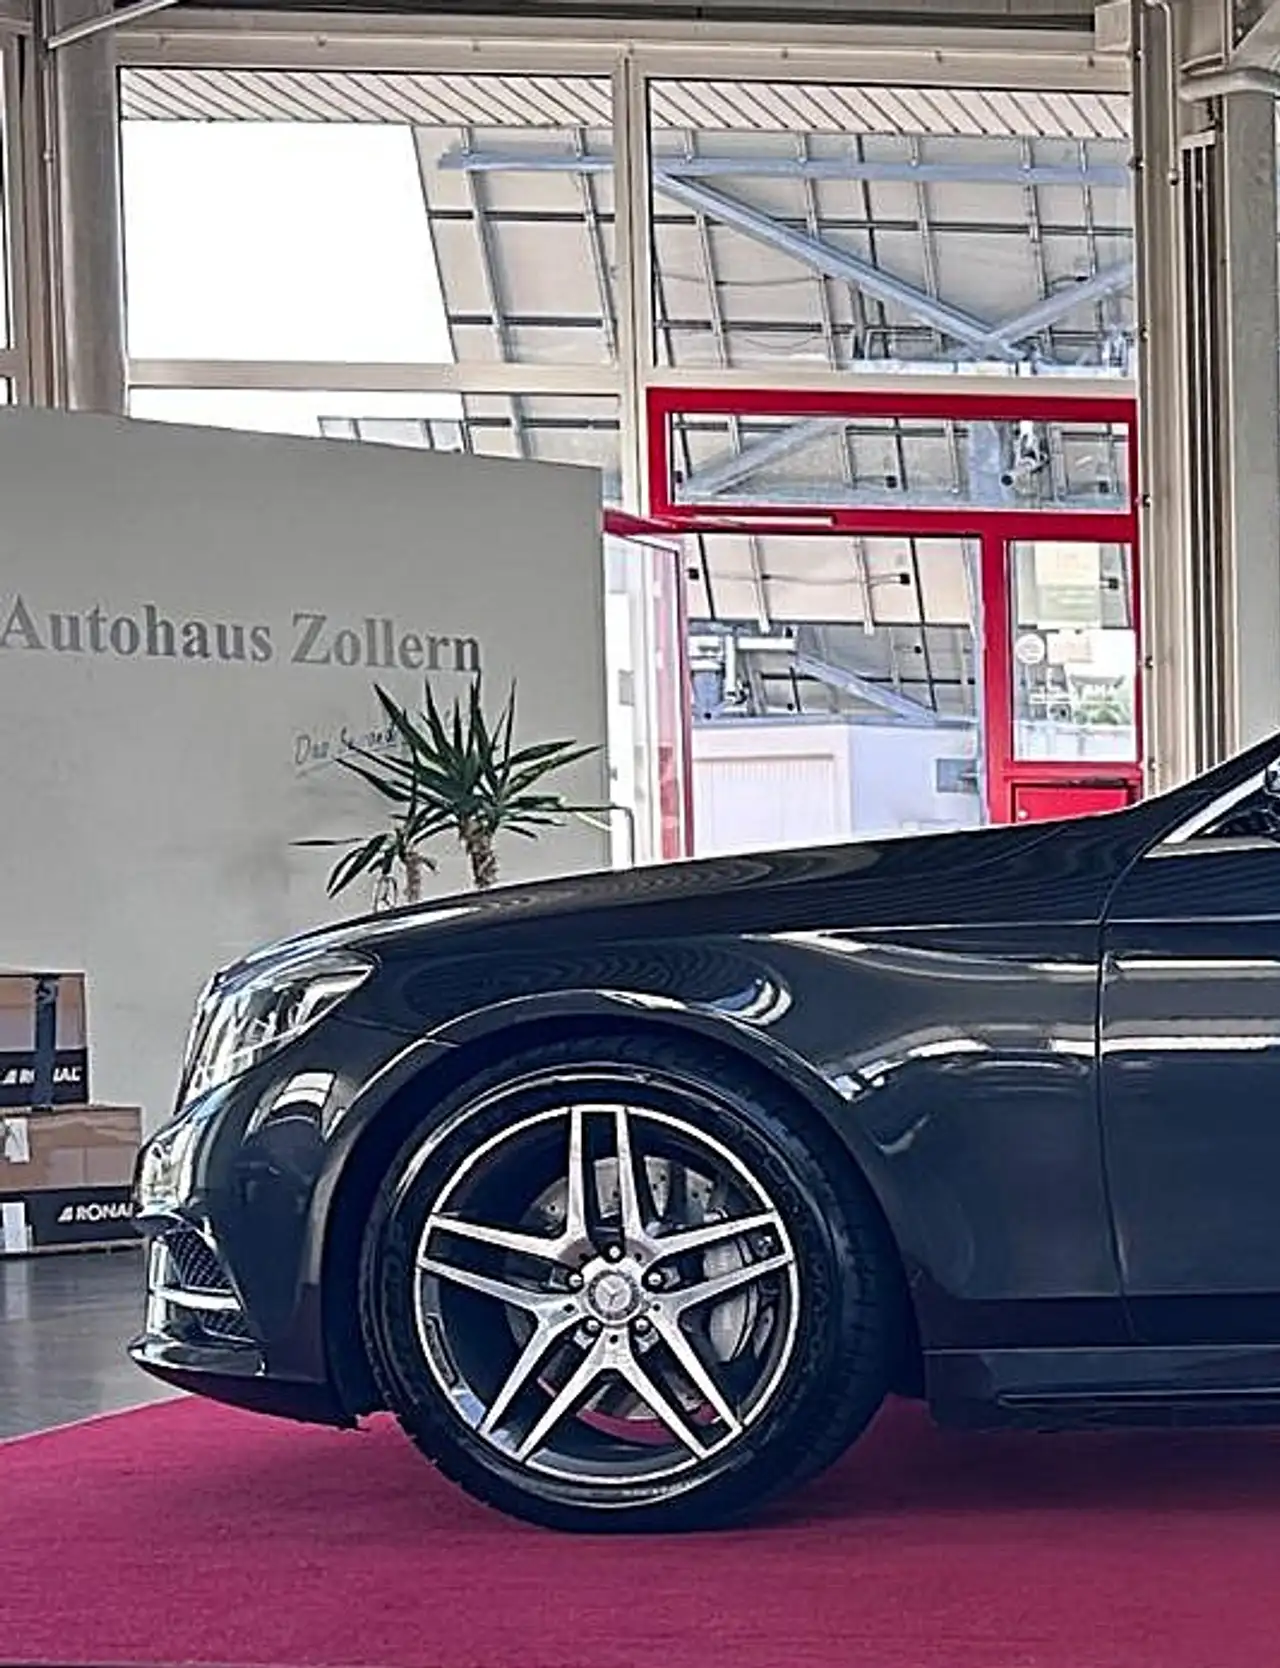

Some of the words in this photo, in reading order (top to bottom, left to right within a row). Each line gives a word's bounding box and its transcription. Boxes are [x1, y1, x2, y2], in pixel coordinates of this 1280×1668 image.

[0, 592, 273, 663] Autohaus
[290, 611, 480, 672] Zollern
[19, 1066, 83, 1085] RAL
